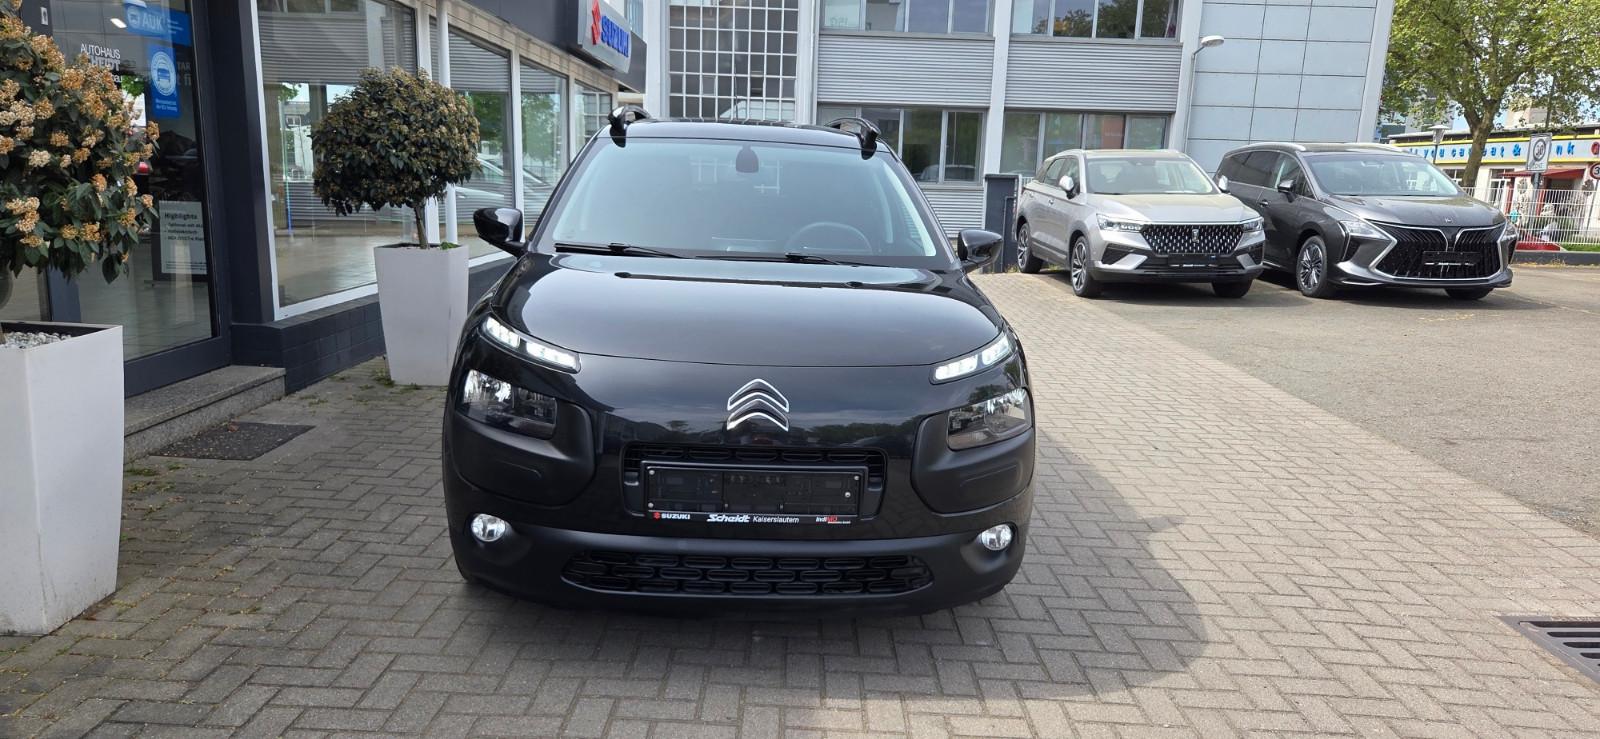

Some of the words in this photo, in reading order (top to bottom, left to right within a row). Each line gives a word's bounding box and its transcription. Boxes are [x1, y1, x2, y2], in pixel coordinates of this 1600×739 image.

[601, 15, 629, 57] SUZUKI
[80, 43, 120, 59] AUTOHAUS
[1512, 143, 1521, 156] &
[752, 515, 800, 524] Kaiserslautern
